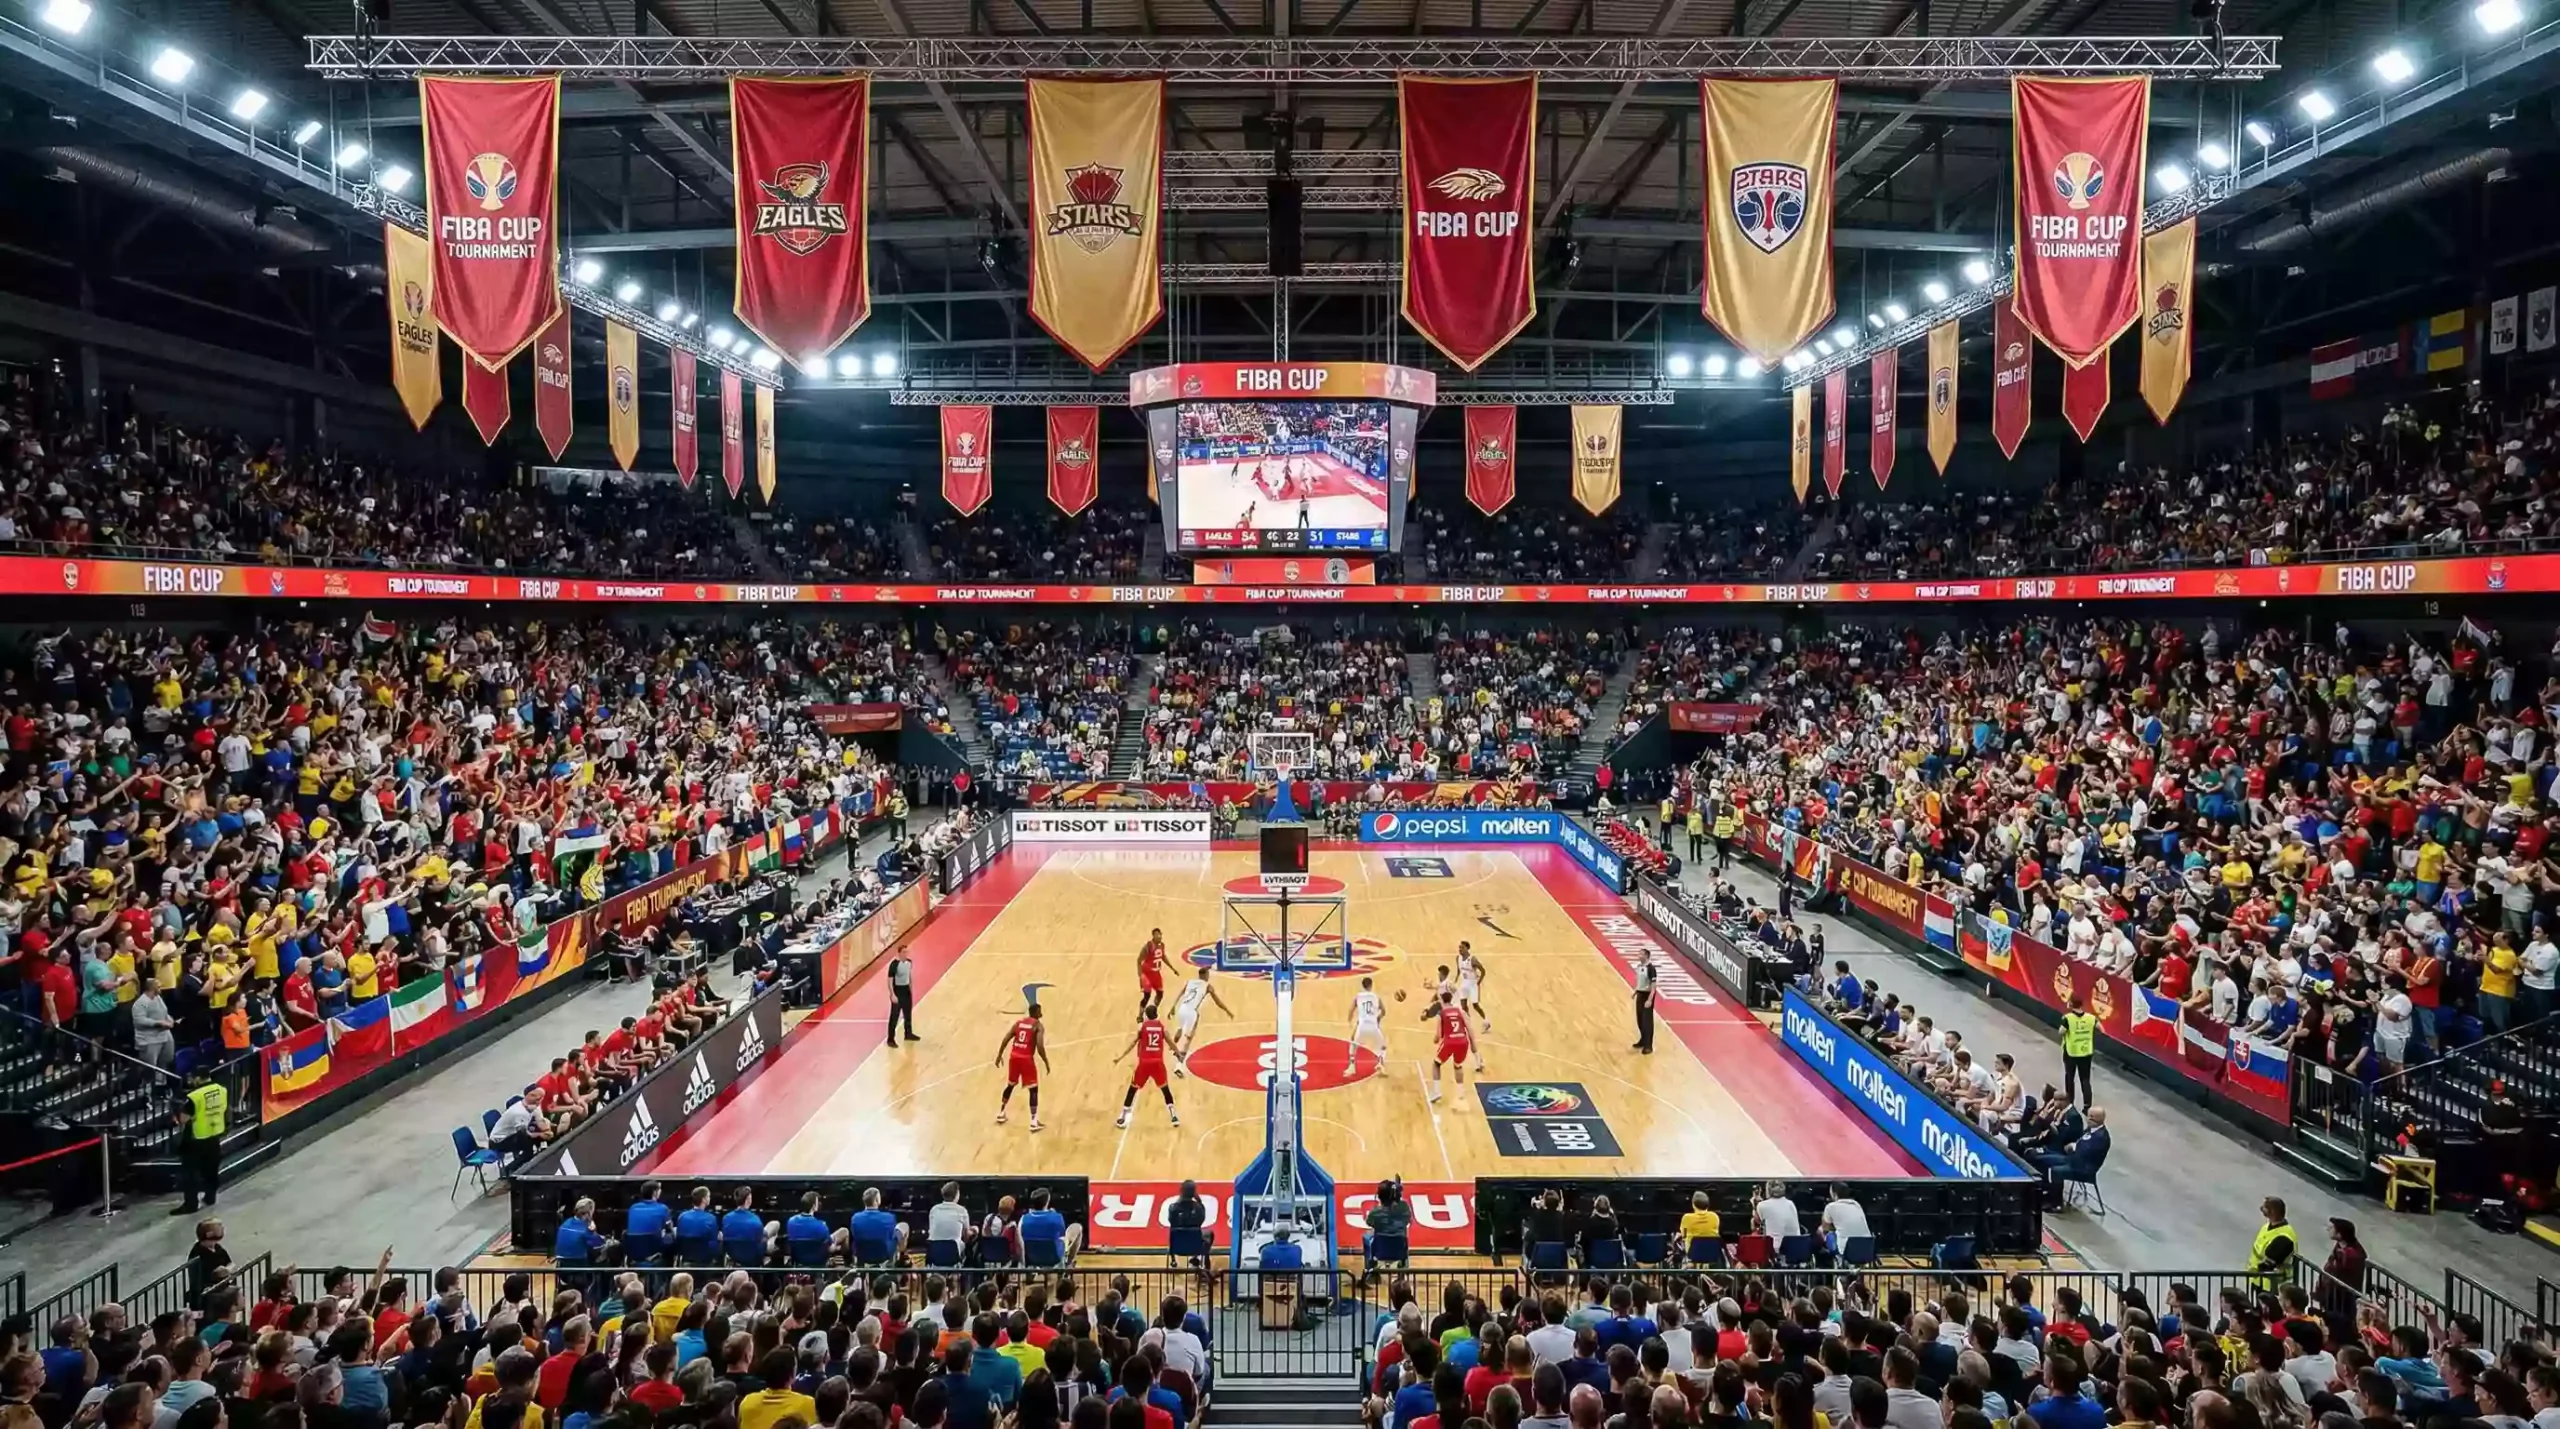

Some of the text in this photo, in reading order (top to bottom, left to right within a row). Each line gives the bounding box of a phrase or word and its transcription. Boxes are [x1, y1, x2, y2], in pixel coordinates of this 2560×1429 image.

[442, 215, 543, 241] FIBA CUP
[757, 203, 846, 233] EAGLES
[1057, 204, 1131, 228] STARS
[1416, 211, 1520, 238] FIBA CUP
[2031, 215, 2128, 240] FIBA CUP
[446, 242, 537, 260] TOURNAMENT
[2035, 242, 2122, 258] TOURNAMENT
[397, 320, 433, 345] EAGLES
[1236, 369, 1329, 390] FIBA CUP
[143, 566, 224, 592] FIBA CUP
[520, 580, 561, 599] FIBA CUP
[2016, 580, 2056, 598] FIBA CUP
[2336, 564, 2417, 591] FIBA CUP
[737, 586, 799, 600] FIBA CUP
[958, 590, 976, 599] CUP
[1112, 588, 1176, 601] FIBA CUP
[1267, 590, 1286, 599] CUP
[1441, 587, 1504, 600] FIBA CUP
[1610, 588, 1628, 599] CUP
[1765, 585, 1829, 600] FIBA CUP
[1042, 820, 1108, 832] TISSOT
[1141, 820, 1207, 832] TISSOT
[1405, 816, 1550, 838] pepsi molten
[626, 896, 648, 927] FIBA
[1148, 1033, 1160, 1046] 12
[1787, 1008, 1835, 1066] molten
[736, 1039, 765, 1072] adidas
[683, 1079, 716, 1116] adidas
[1847, 1058, 1907, 1126] molten
[620, 1125, 660, 1167] adidas
[1544, 1123, 1596, 1150] FIBA
[1921, 1118, 1996, 1178] molten
